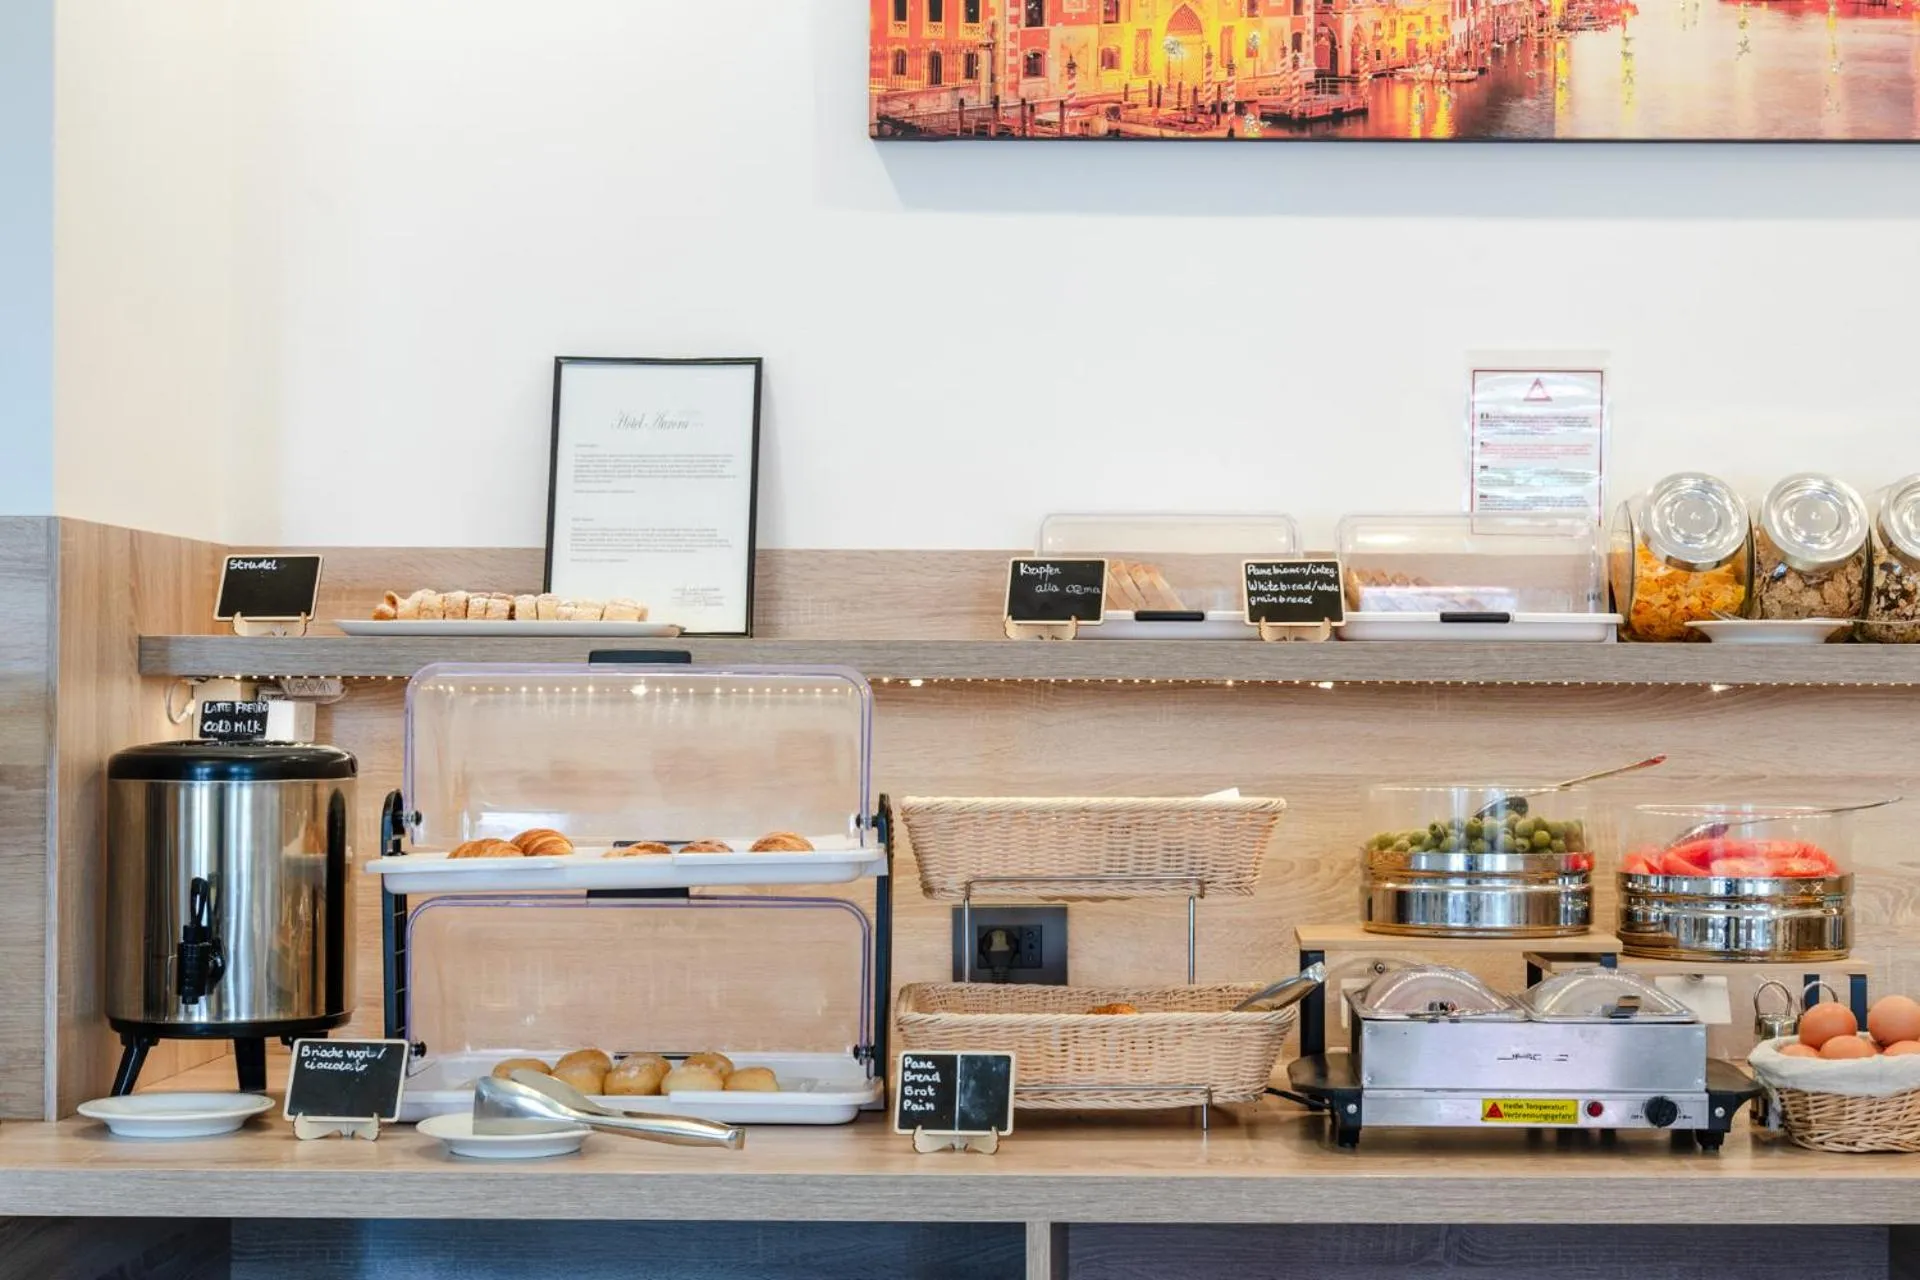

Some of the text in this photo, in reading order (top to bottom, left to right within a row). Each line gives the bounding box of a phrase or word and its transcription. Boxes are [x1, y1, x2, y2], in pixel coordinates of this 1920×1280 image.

[229, 559, 277, 570] Strudel
[903, 1070, 941, 1083] Bread
[903, 1099, 935, 1111] Pain
